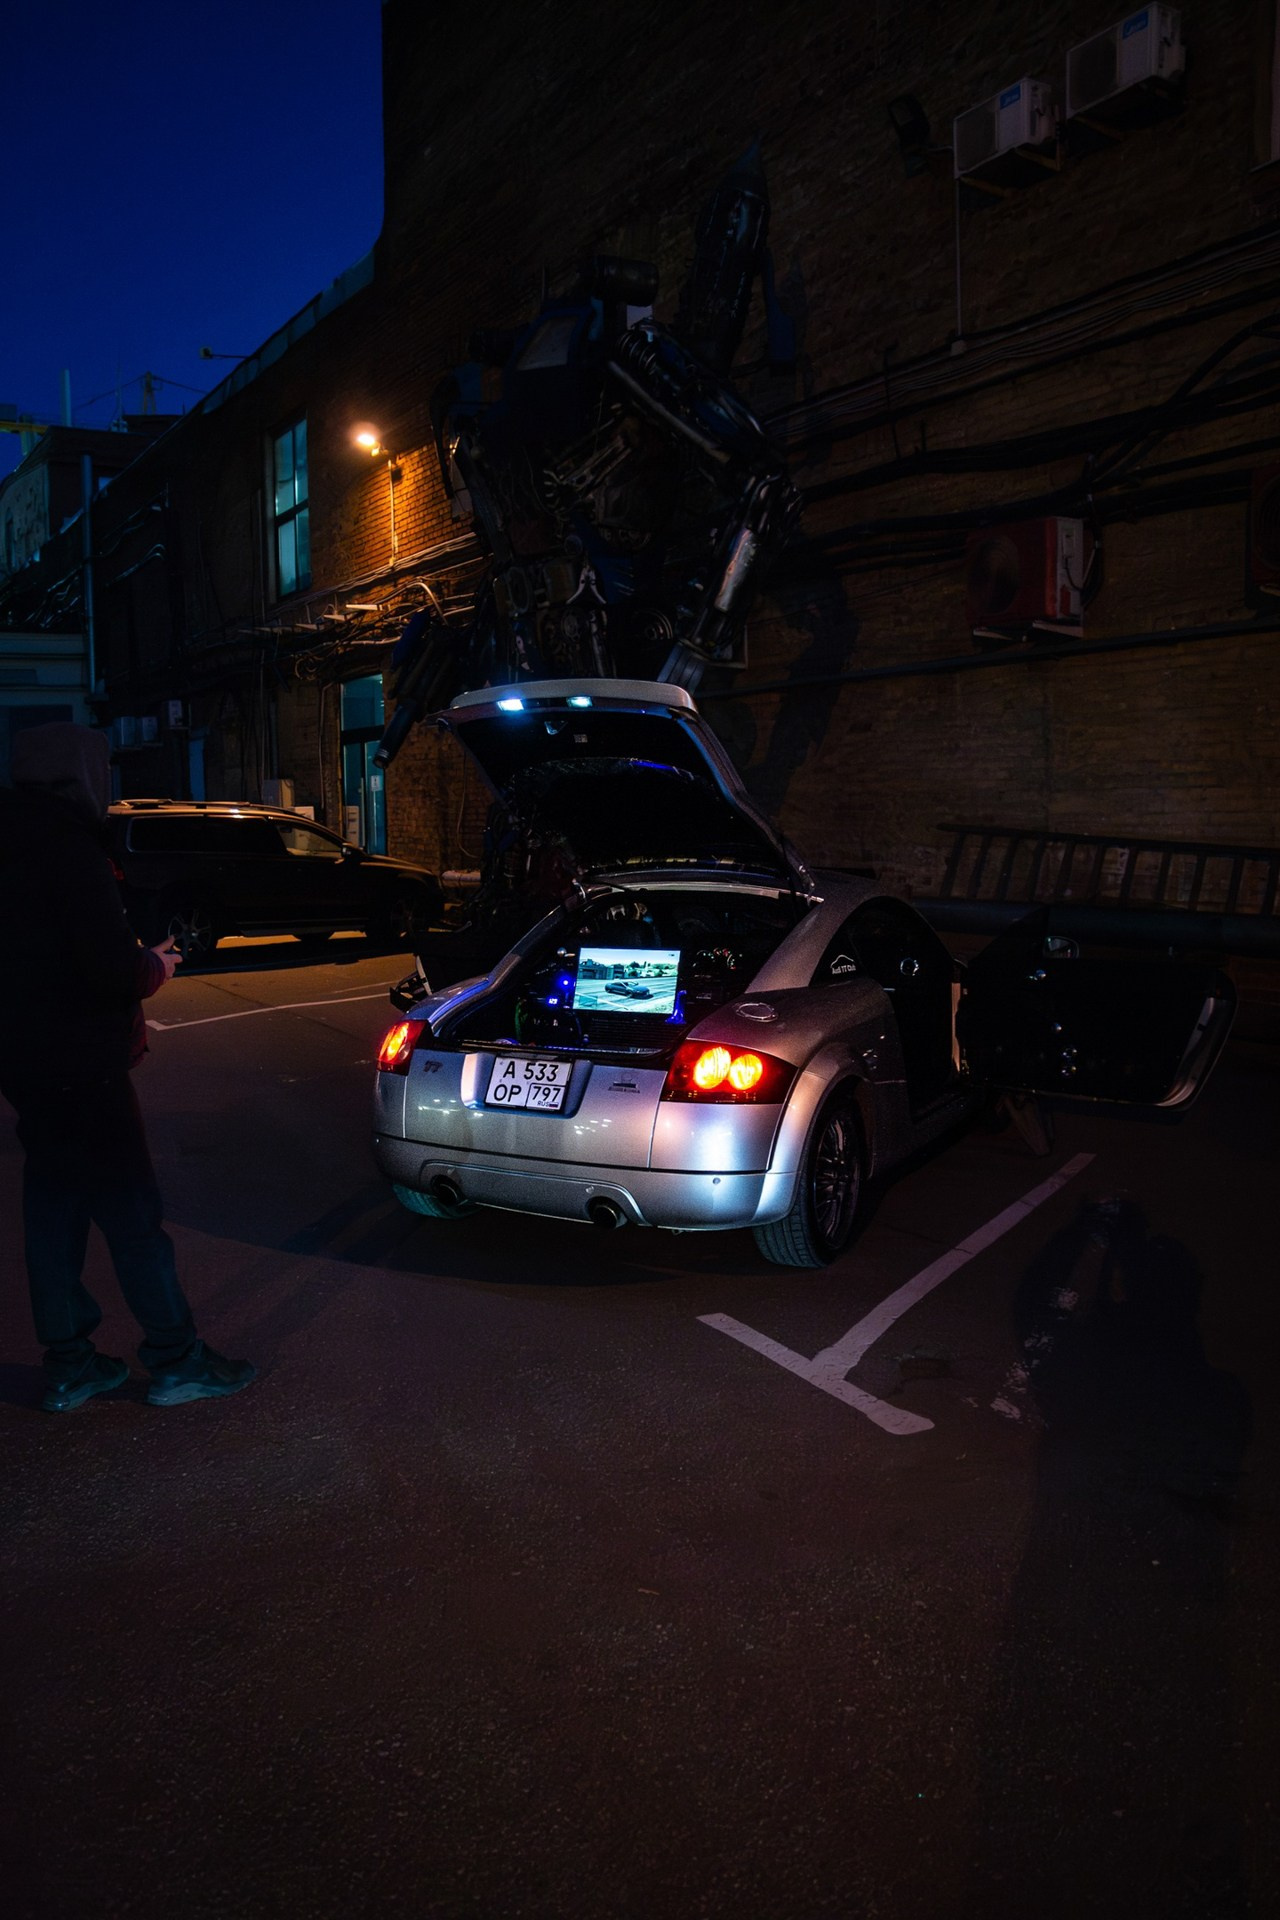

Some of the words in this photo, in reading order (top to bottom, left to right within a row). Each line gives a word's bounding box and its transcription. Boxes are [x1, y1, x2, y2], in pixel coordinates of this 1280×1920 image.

[503, 1061, 515, 1079] A
[523, 1062, 559, 1082] 533
[494, 1084, 522, 1103] OP
[532, 1086, 561, 1102] 797
